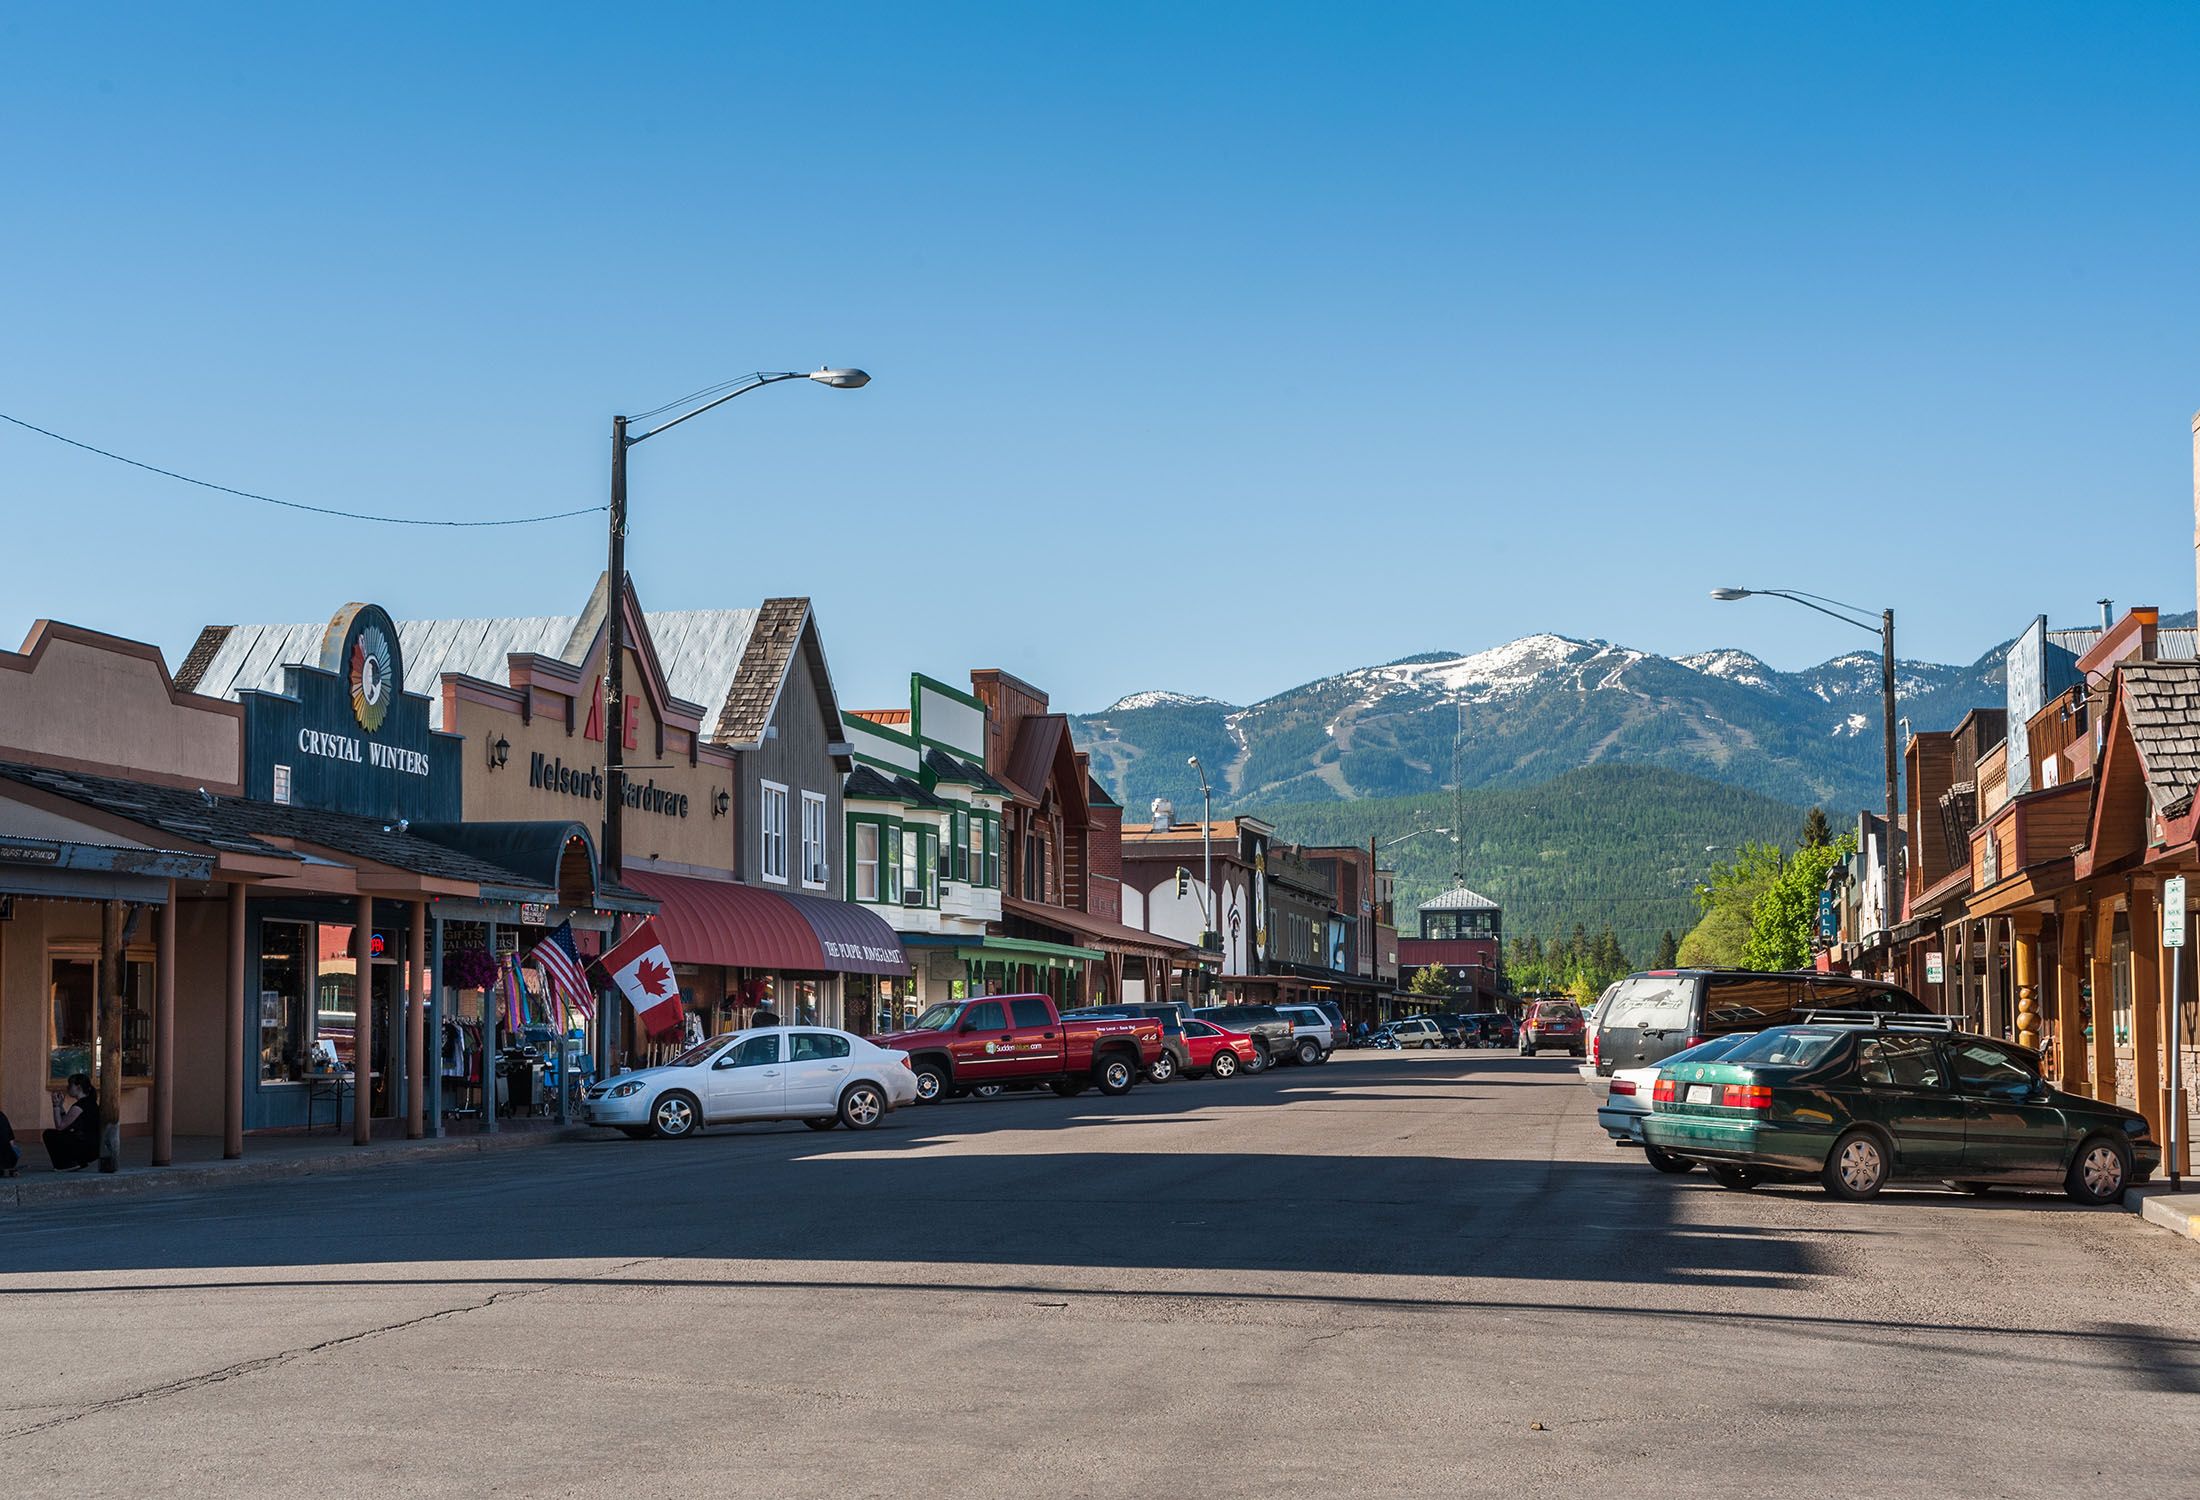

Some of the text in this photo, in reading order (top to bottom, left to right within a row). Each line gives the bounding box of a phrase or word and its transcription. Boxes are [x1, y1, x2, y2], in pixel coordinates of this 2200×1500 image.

[583, 674, 640, 750] AE
[298, 728, 429, 776] CRYSTAL WINTERS
[529, 751, 603, 801] Nelson's
[444, 929, 484, 941] GIFTS
[1822, 897, 1831, 941] PALA
[824, 941, 840, 958] THE
[838, 943, 863, 960] PURPLE
